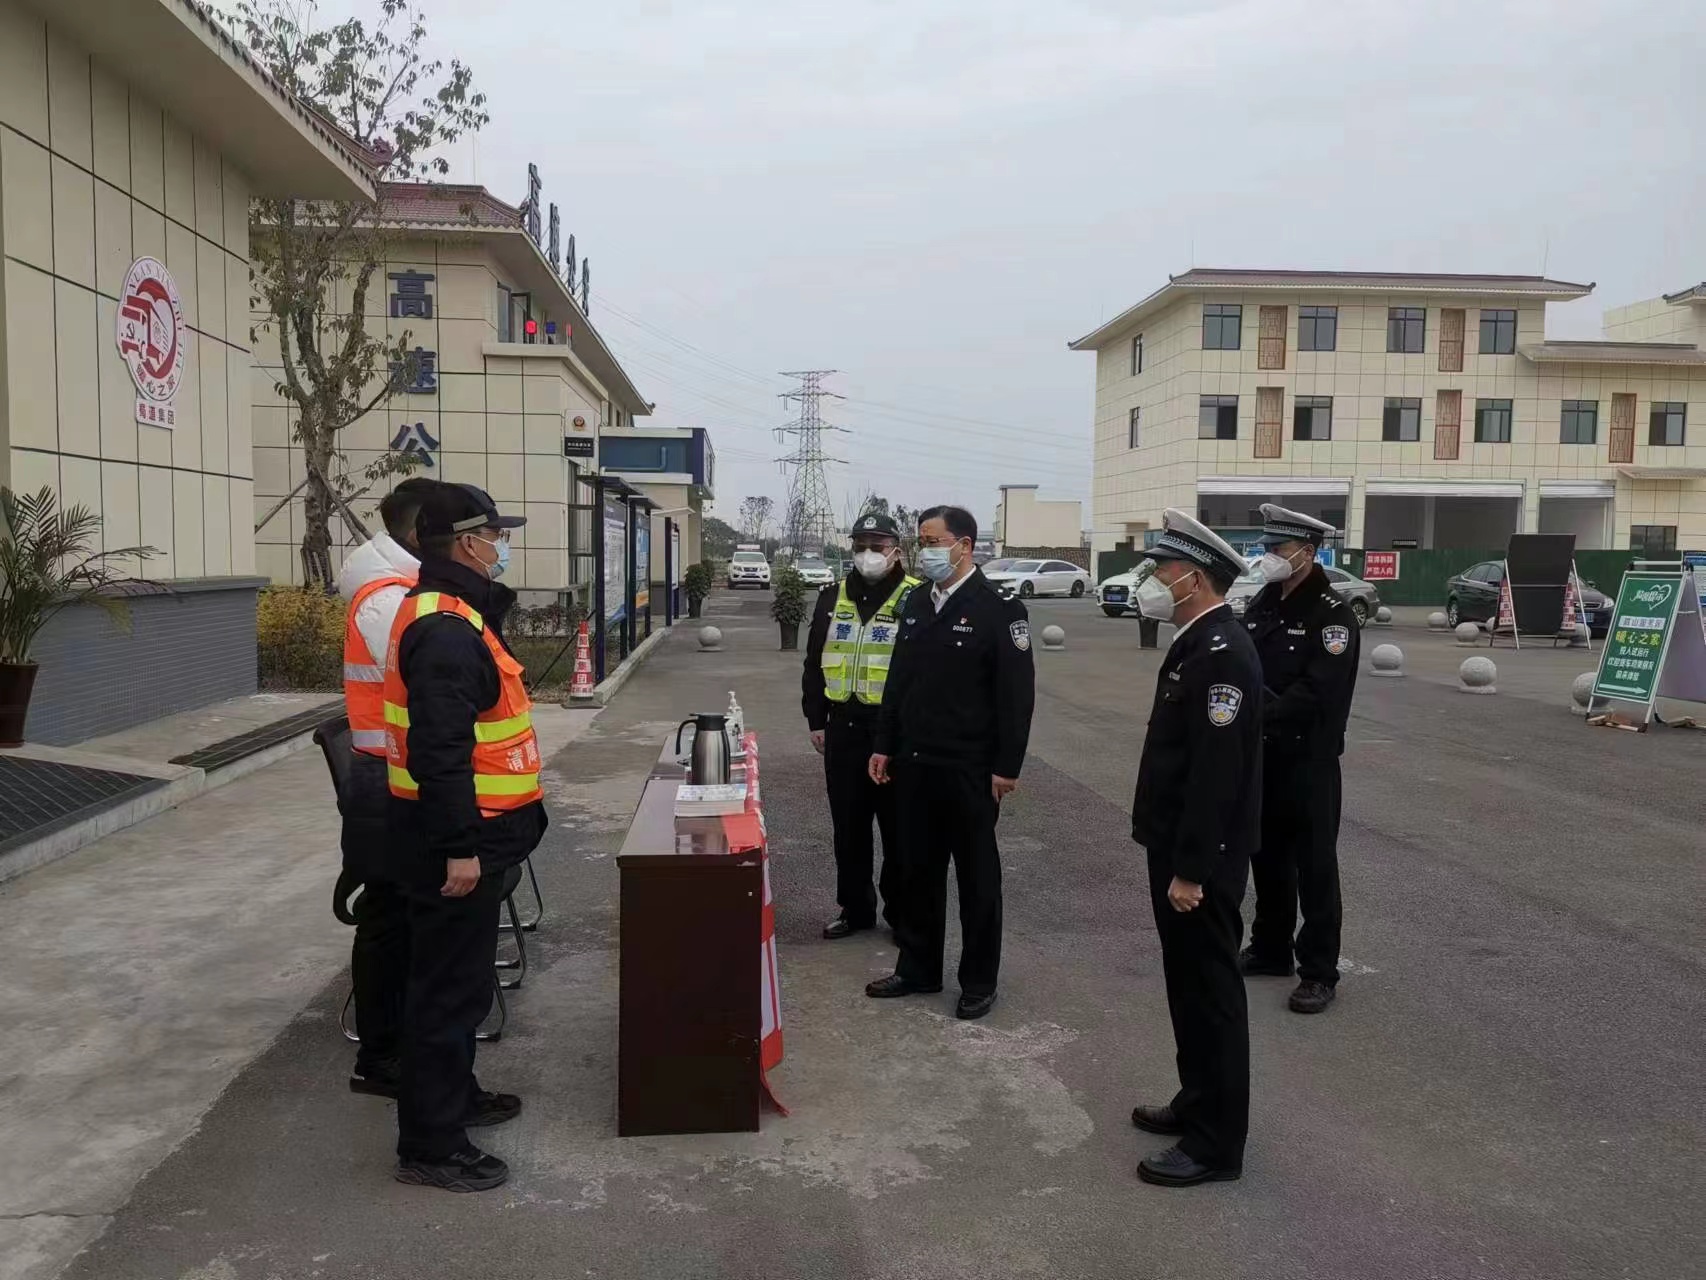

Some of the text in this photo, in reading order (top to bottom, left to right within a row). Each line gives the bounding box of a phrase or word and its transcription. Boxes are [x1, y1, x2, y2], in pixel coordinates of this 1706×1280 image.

[836, 623, 891, 642] 警察
[1615, 630, 1661, 646] 暖心之家
